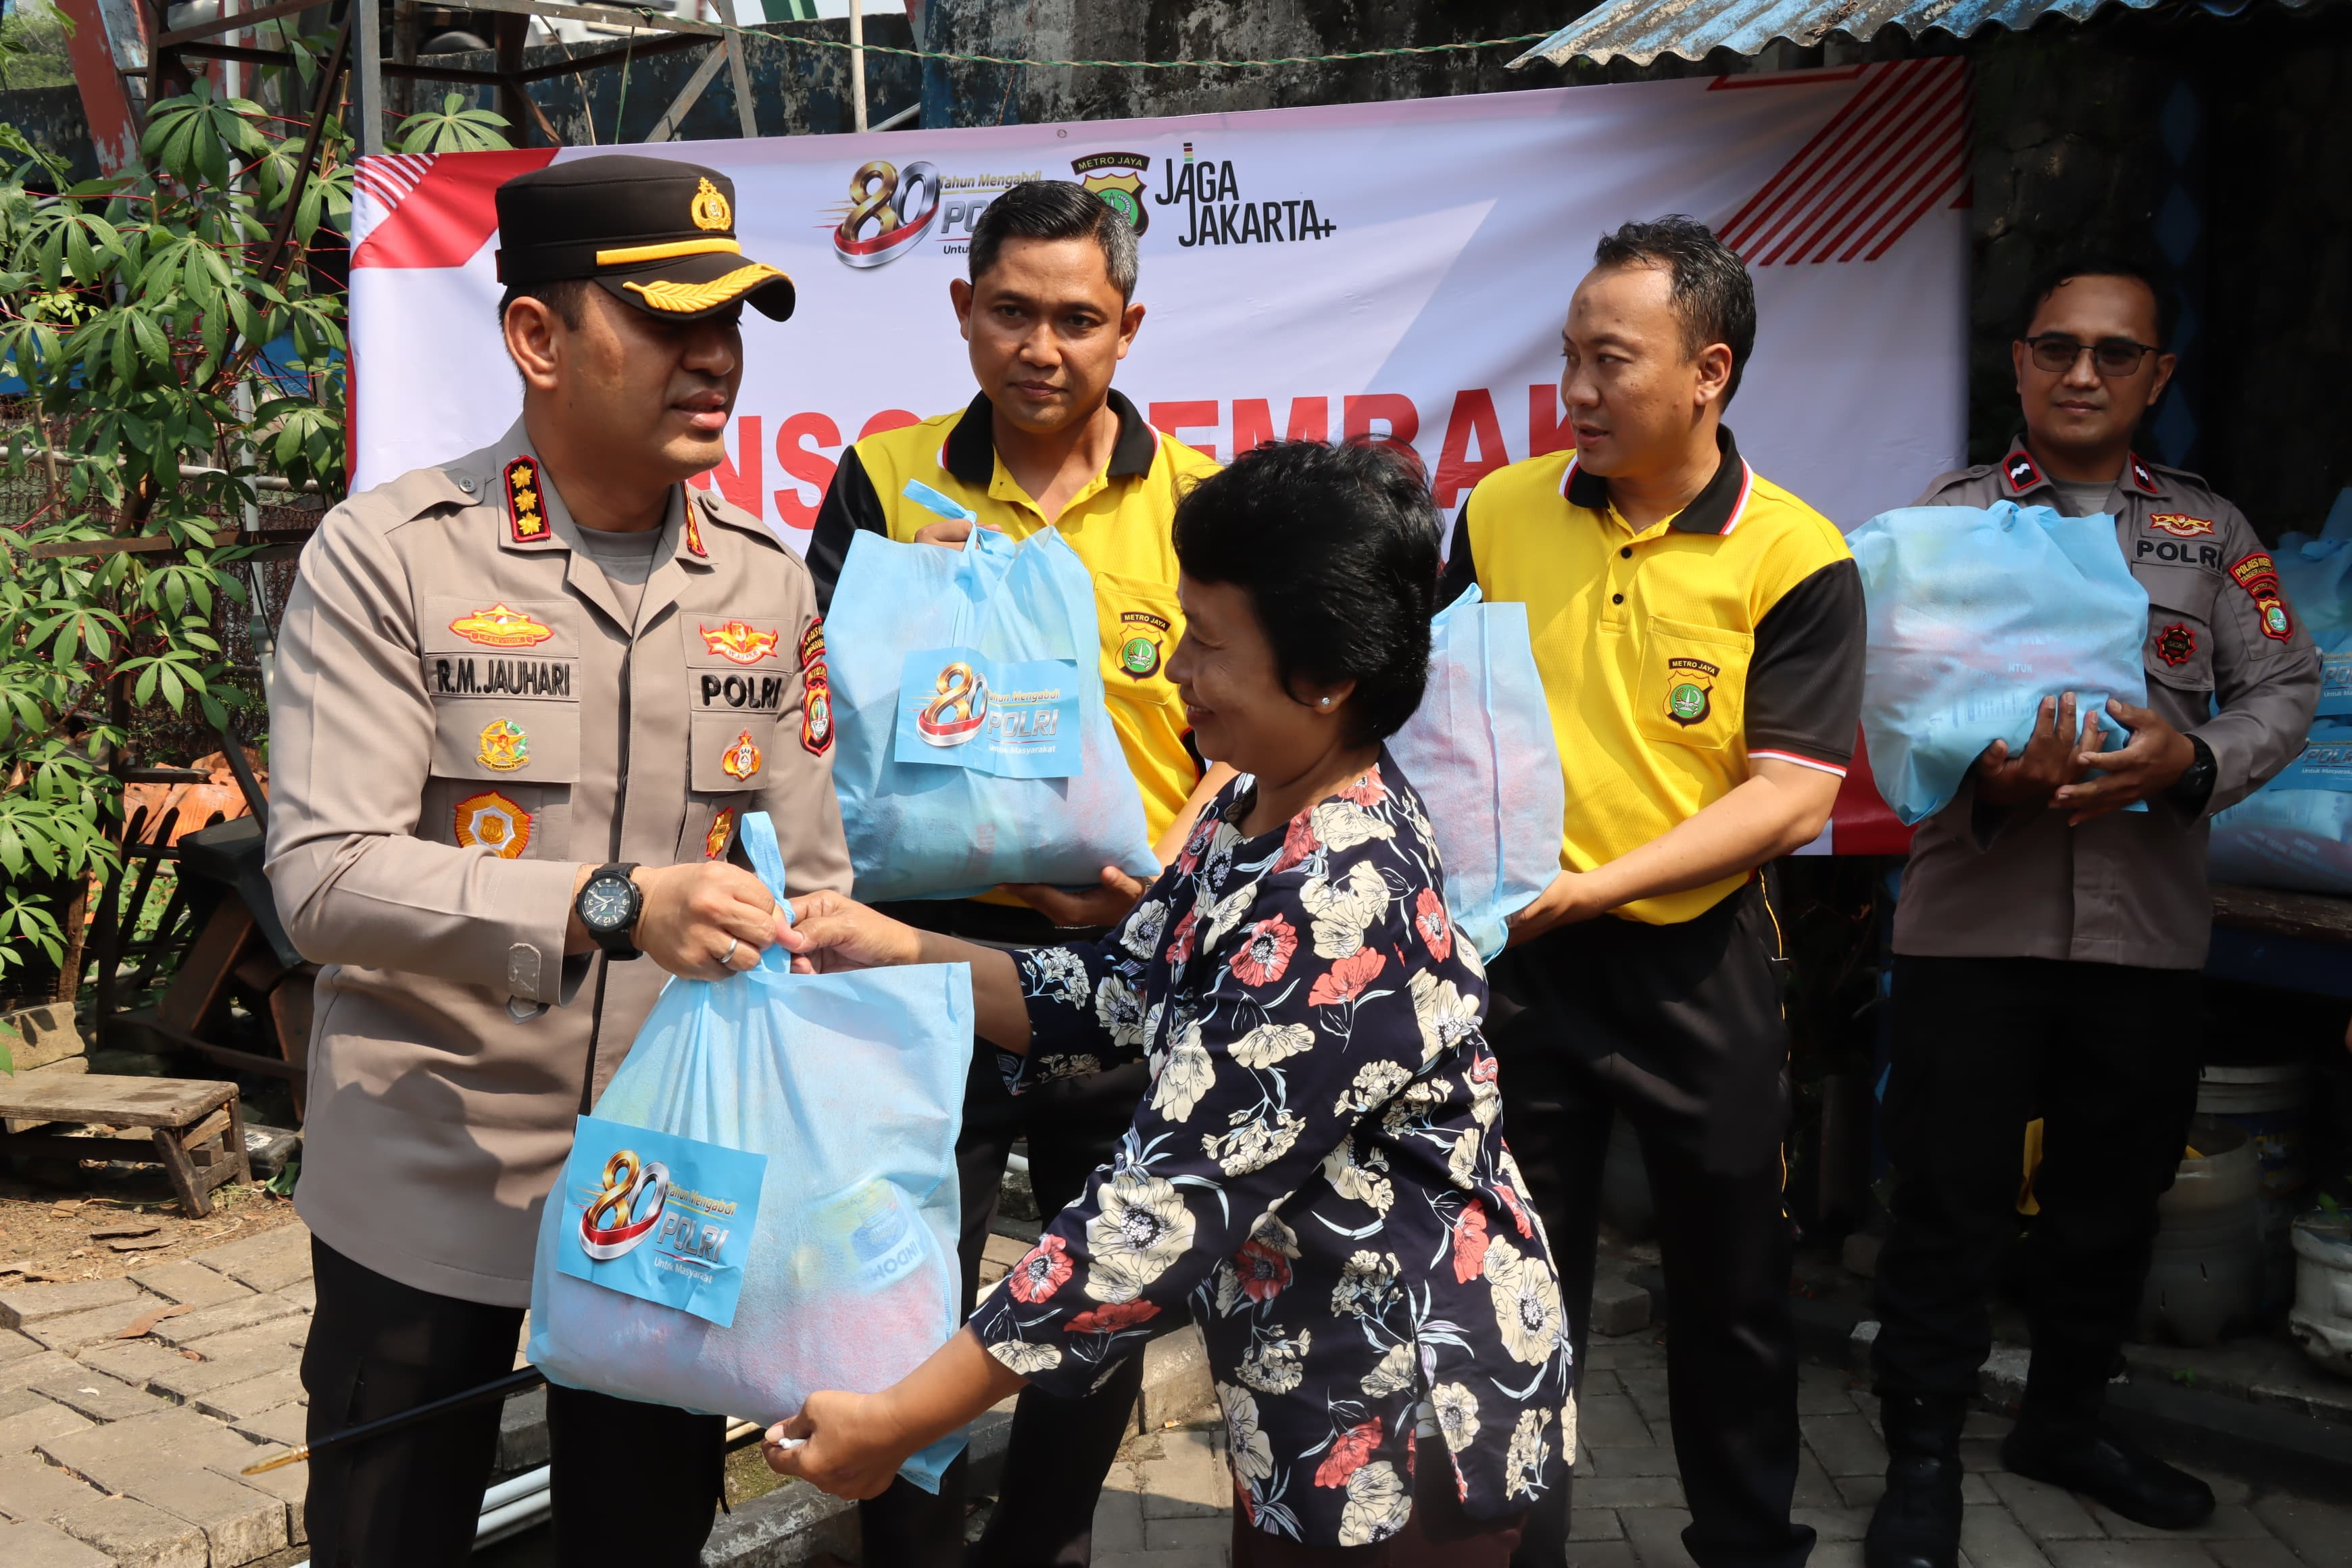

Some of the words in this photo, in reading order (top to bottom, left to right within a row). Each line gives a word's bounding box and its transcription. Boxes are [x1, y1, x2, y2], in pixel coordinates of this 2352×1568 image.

[1078, 156, 1114, 170] METRO
[1118, 157, 1142, 167] JAYA
[939, 174, 975, 189] Tahun
[1155, 158, 1240, 205] JAGA
[835, 161, 940, 257] 80
[944, 245, 970, 254] Untu
[2137, 539, 2223, 570] POLRI
[1150, 618, 1166, 629] JAYA
[1698, 664, 1715, 674] JAYA
[2009, 662, 2033, 673] NTUK
[701, 675, 782, 708] POLRI
[919, 662, 988, 740] 80
[987, 709, 1060, 737] POLRI
[1010, 745, 1056, 755] Masyarakat
[581, 1149, 670, 1254] 80
[689, 1190, 737, 1216] Mengabdi
[657, 1210, 730, 1264] POLRI
